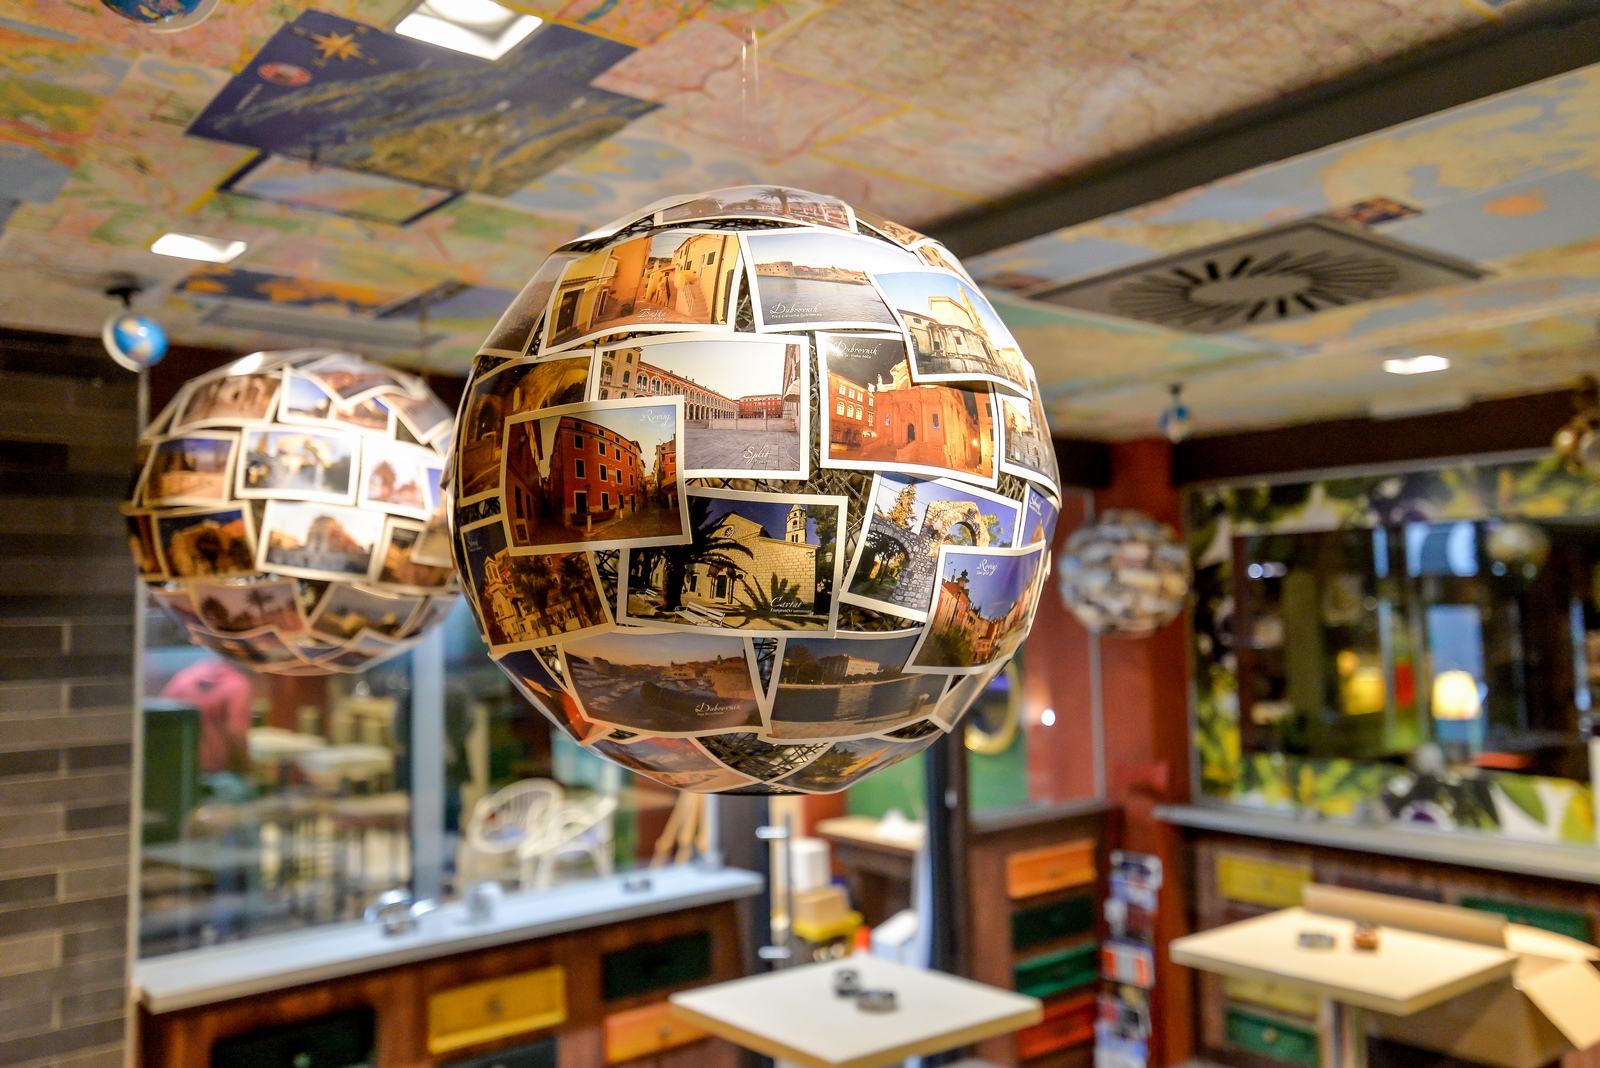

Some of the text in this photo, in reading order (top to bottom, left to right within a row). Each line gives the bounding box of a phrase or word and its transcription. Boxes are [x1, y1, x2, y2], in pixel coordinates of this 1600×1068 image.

[769, 302, 821, 314] Dubrovnik
[833, 340, 882, 355] Dubrovnik
[640, 409, 672, 428] Rovinj
[743, 444, 771, 465] Split
[976, 558, 999, 576] Rovinj
[770, 595, 803, 608] Cavtat
[694, 700, 744, 712] Dubrovnik
